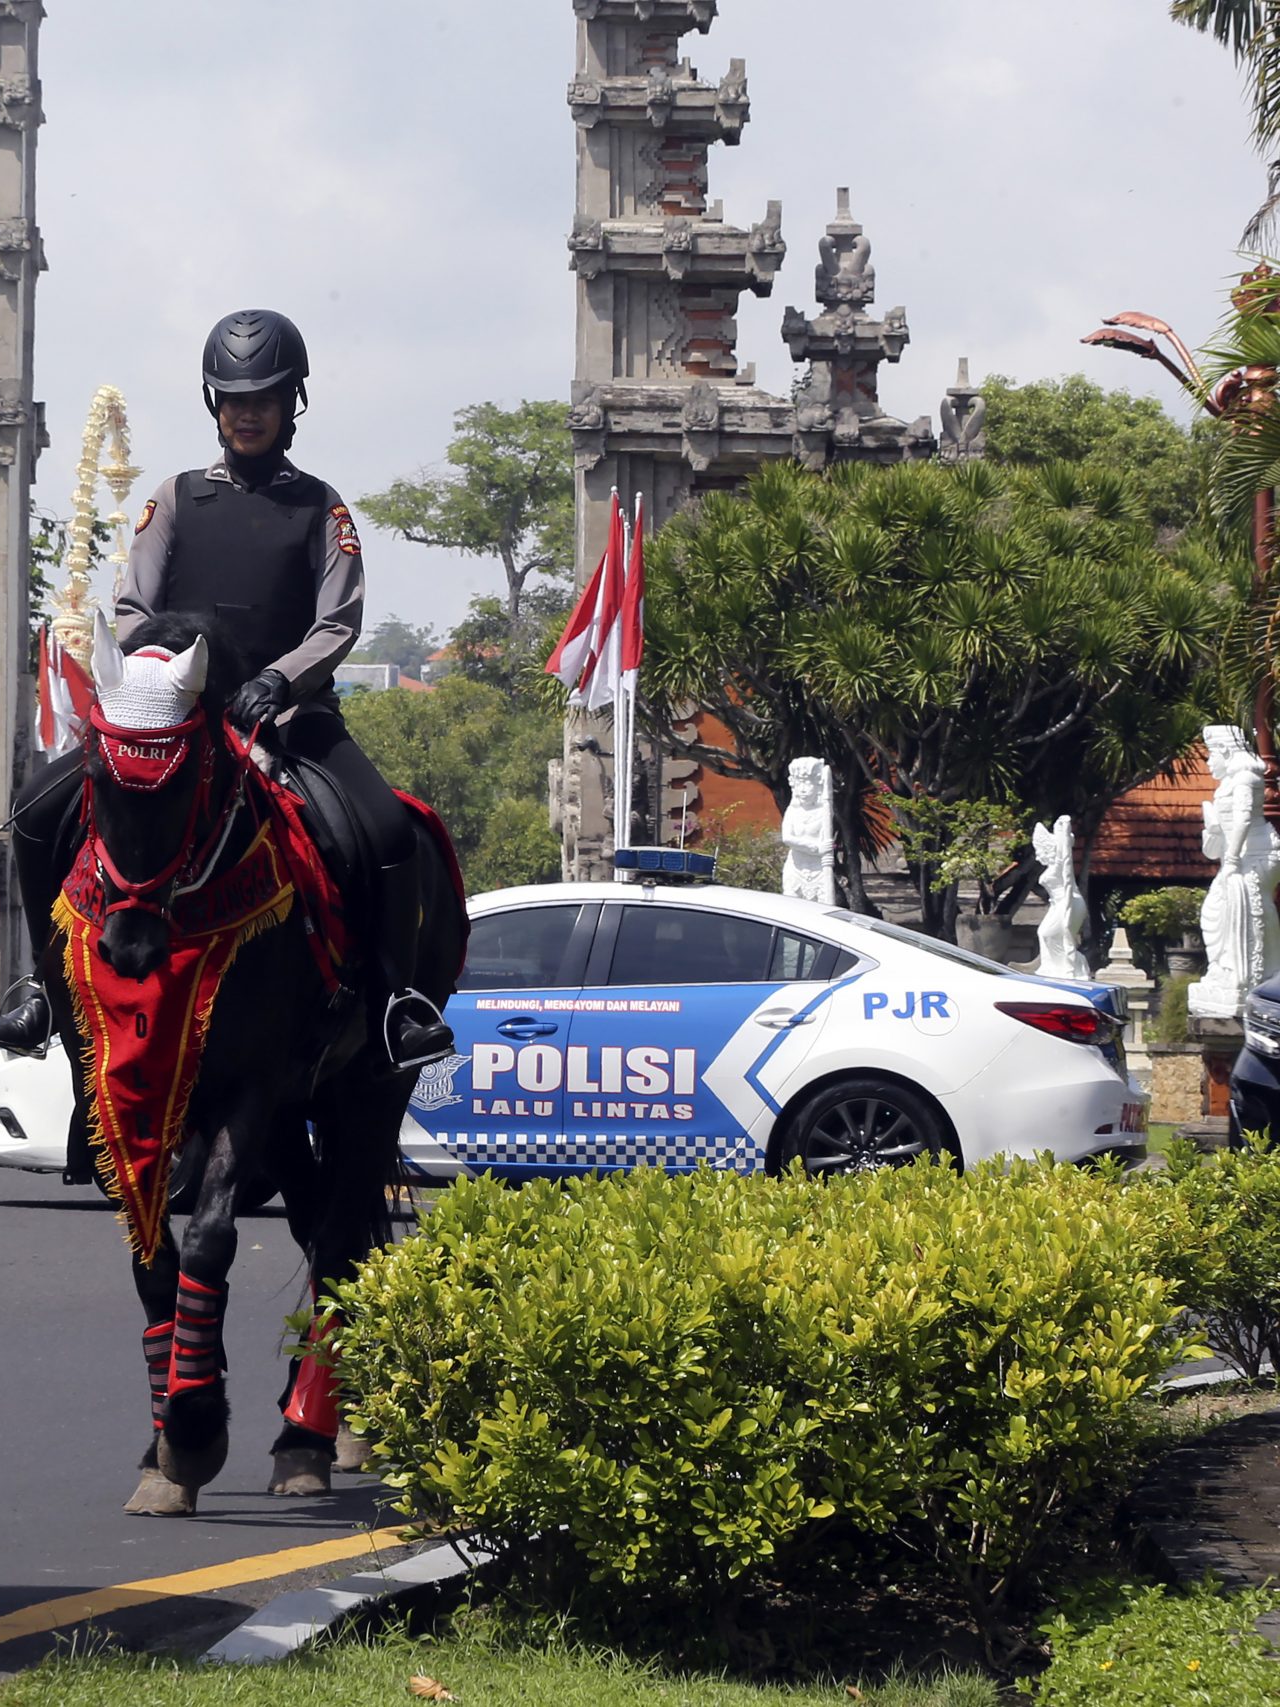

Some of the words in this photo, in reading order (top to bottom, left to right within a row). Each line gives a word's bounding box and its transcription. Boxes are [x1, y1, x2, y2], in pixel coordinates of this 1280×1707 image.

[116, 744, 167, 760] POLRI
[476, 999, 542, 1012] MELINDUNGI,
[544, 1000, 605, 1011] MENGAYOMI
[607, 1001, 628, 1011] DAN
[630, 1001, 680, 1012] MELAYANI
[863, 990, 951, 1020] PJR
[472, 1043, 695, 1095] POLISI
[133, 978, 152, 1194] OLRI
[472, 1099, 554, 1117] LALU
[573, 1101, 694, 1120] LINTAS
